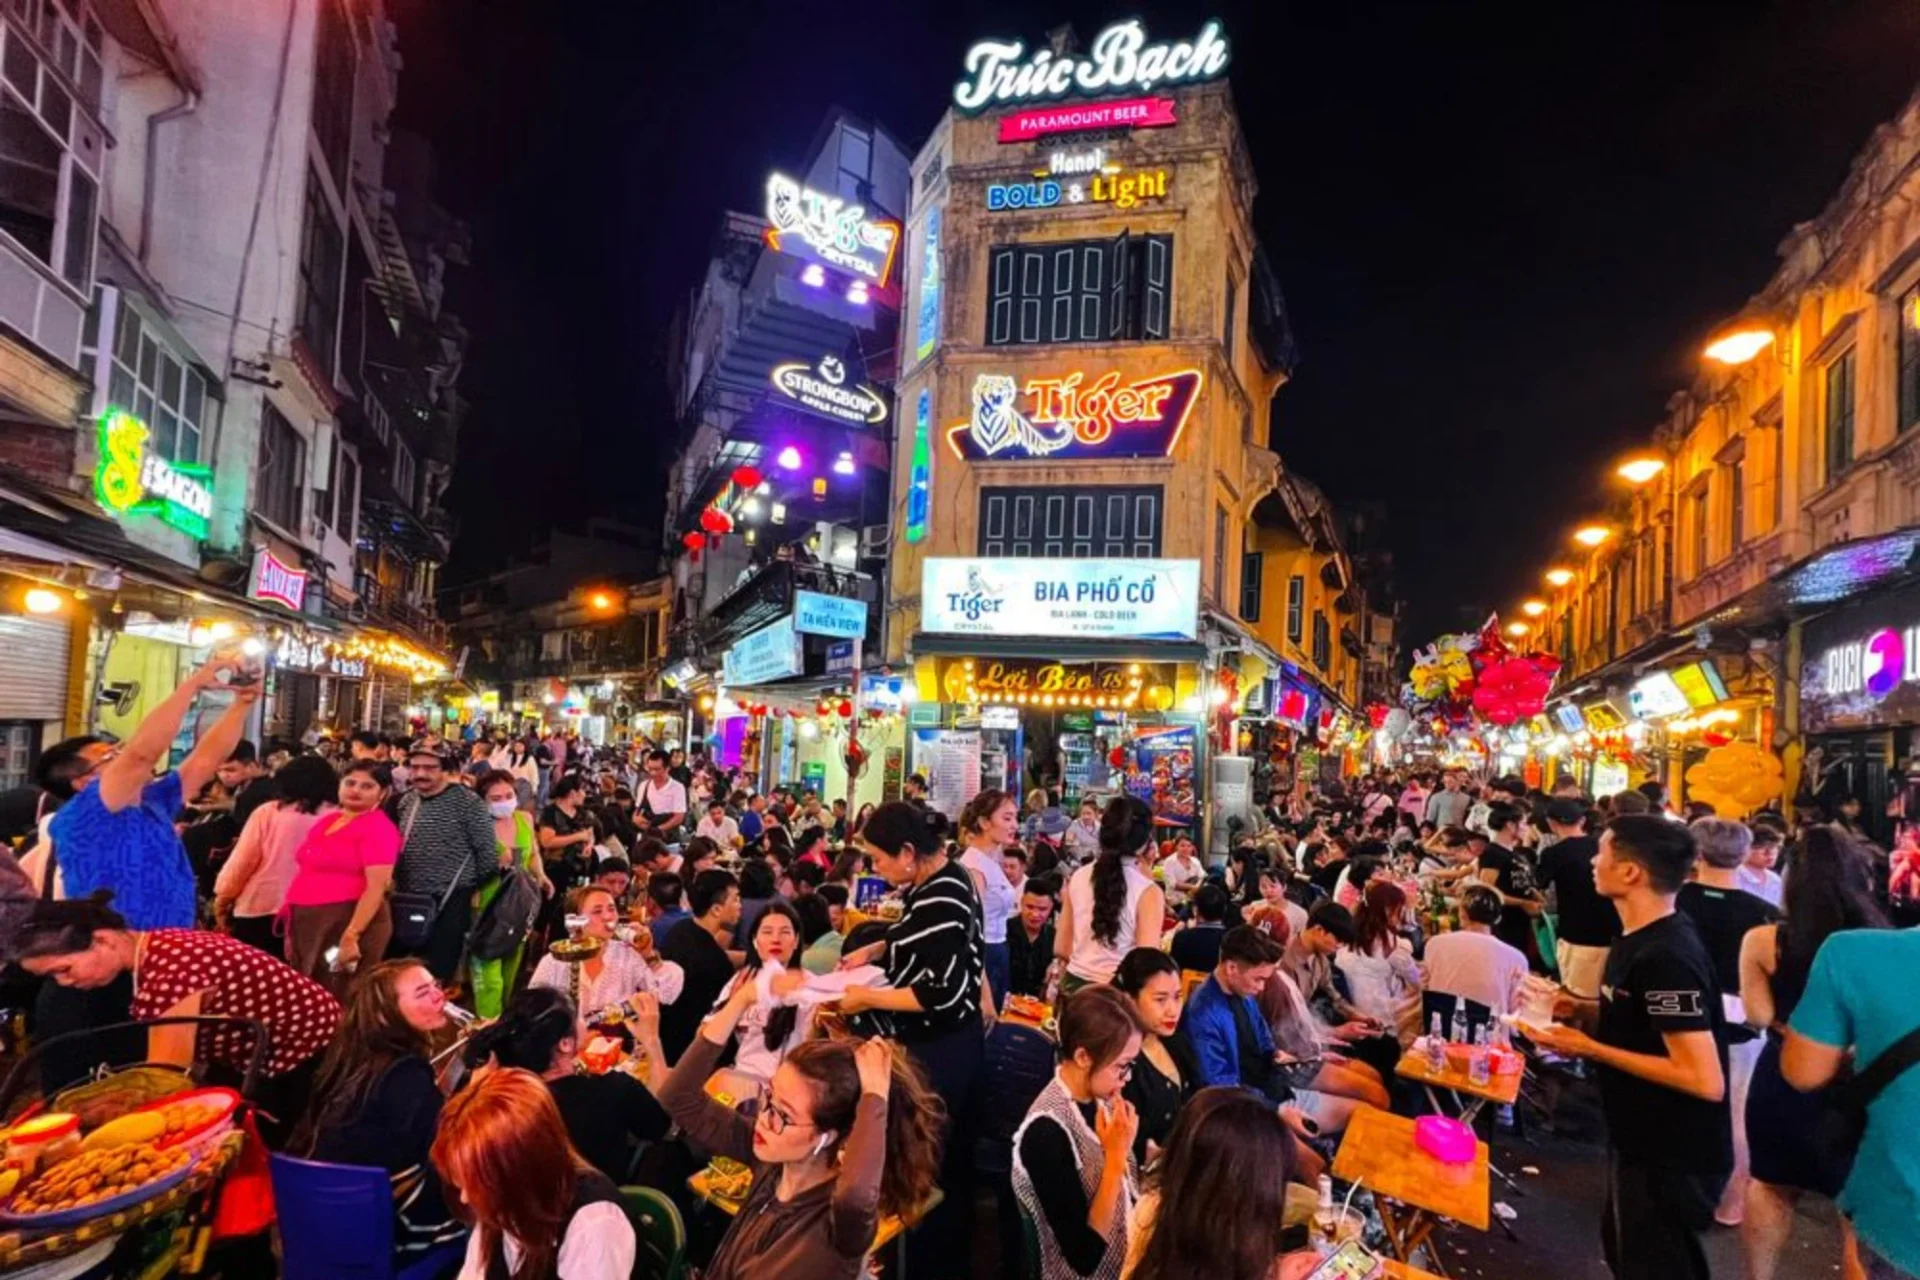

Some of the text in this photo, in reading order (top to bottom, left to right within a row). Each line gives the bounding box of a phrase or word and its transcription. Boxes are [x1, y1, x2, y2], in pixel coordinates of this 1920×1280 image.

[955, 20, 1227, 109] Trúc Bạch
[1020, 104, 1149, 131] PARAMOUNT BEER
[988, 171, 1167, 210] BOLD & Light
[785, 372, 876, 413] STRONGBOW
[1026, 372, 1171, 444] Tiger
[947, 592, 1004, 621] Tiger
[1034, 582, 1068, 603] BIA
[1076, 575, 1122, 603] PHỐ
